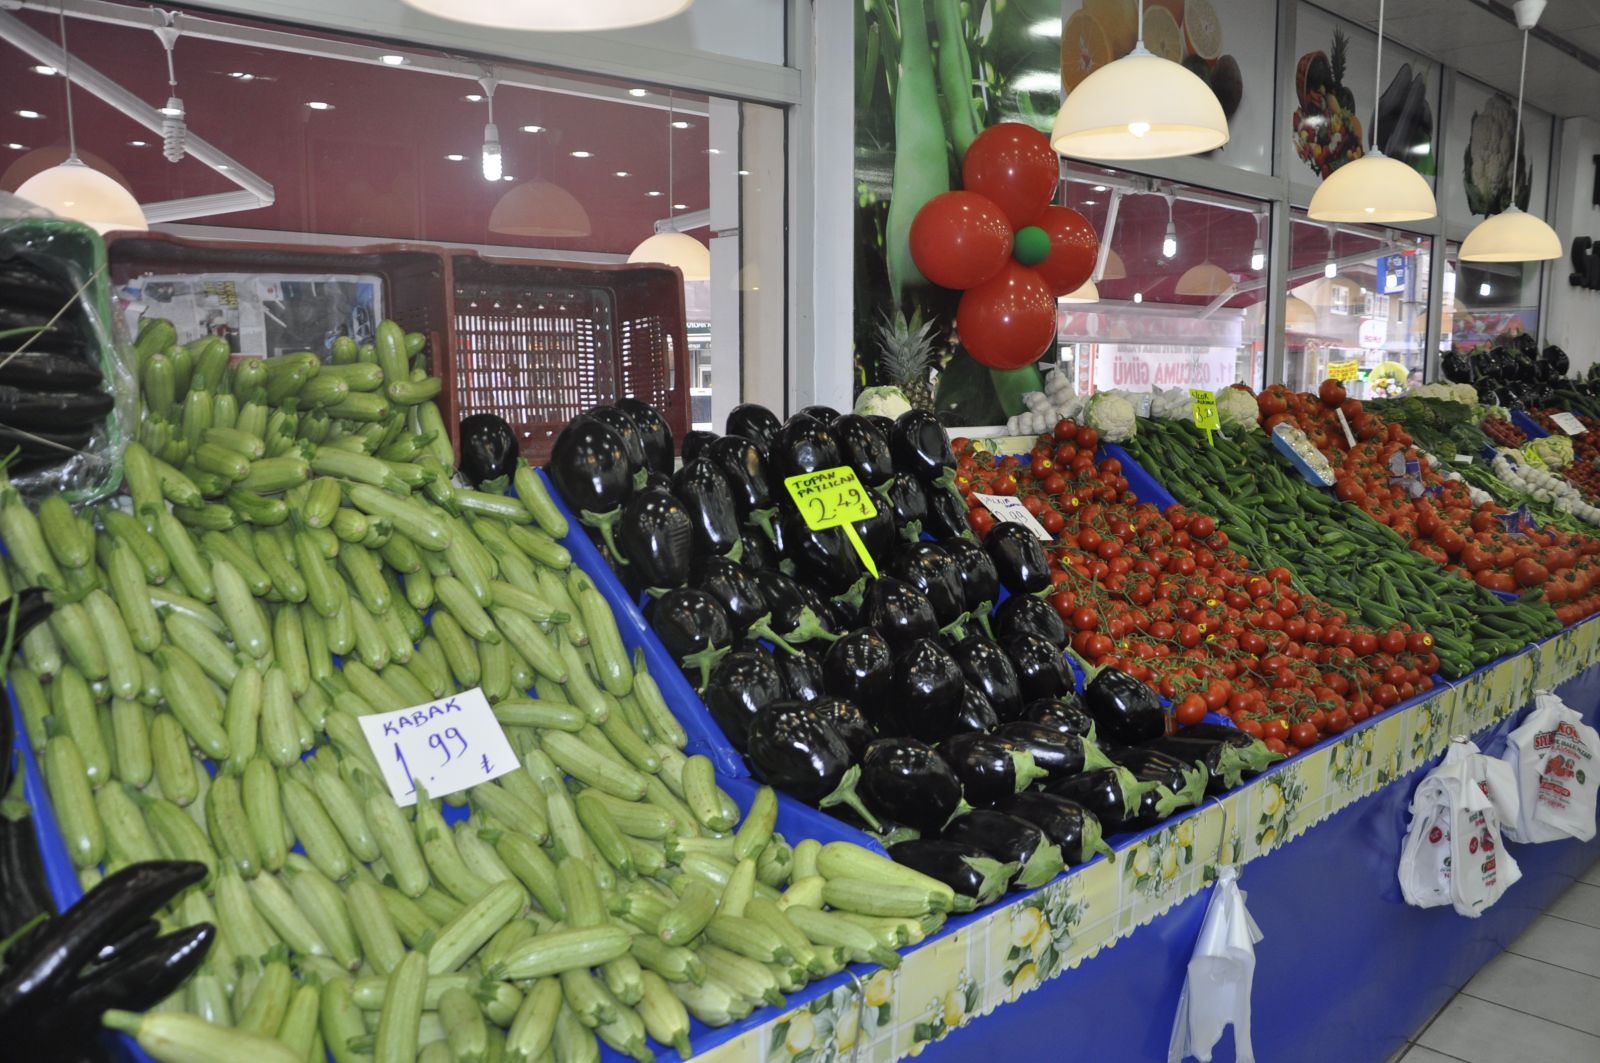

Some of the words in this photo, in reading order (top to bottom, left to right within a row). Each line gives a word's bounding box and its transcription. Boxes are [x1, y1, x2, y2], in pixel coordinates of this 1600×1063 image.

[792, 471, 836, 489] TOPAN
[797, 473, 856, 498] PATLICAN
[808, 488, 862, 523] 2.49
[383, 697, 462, 736] KABAK
